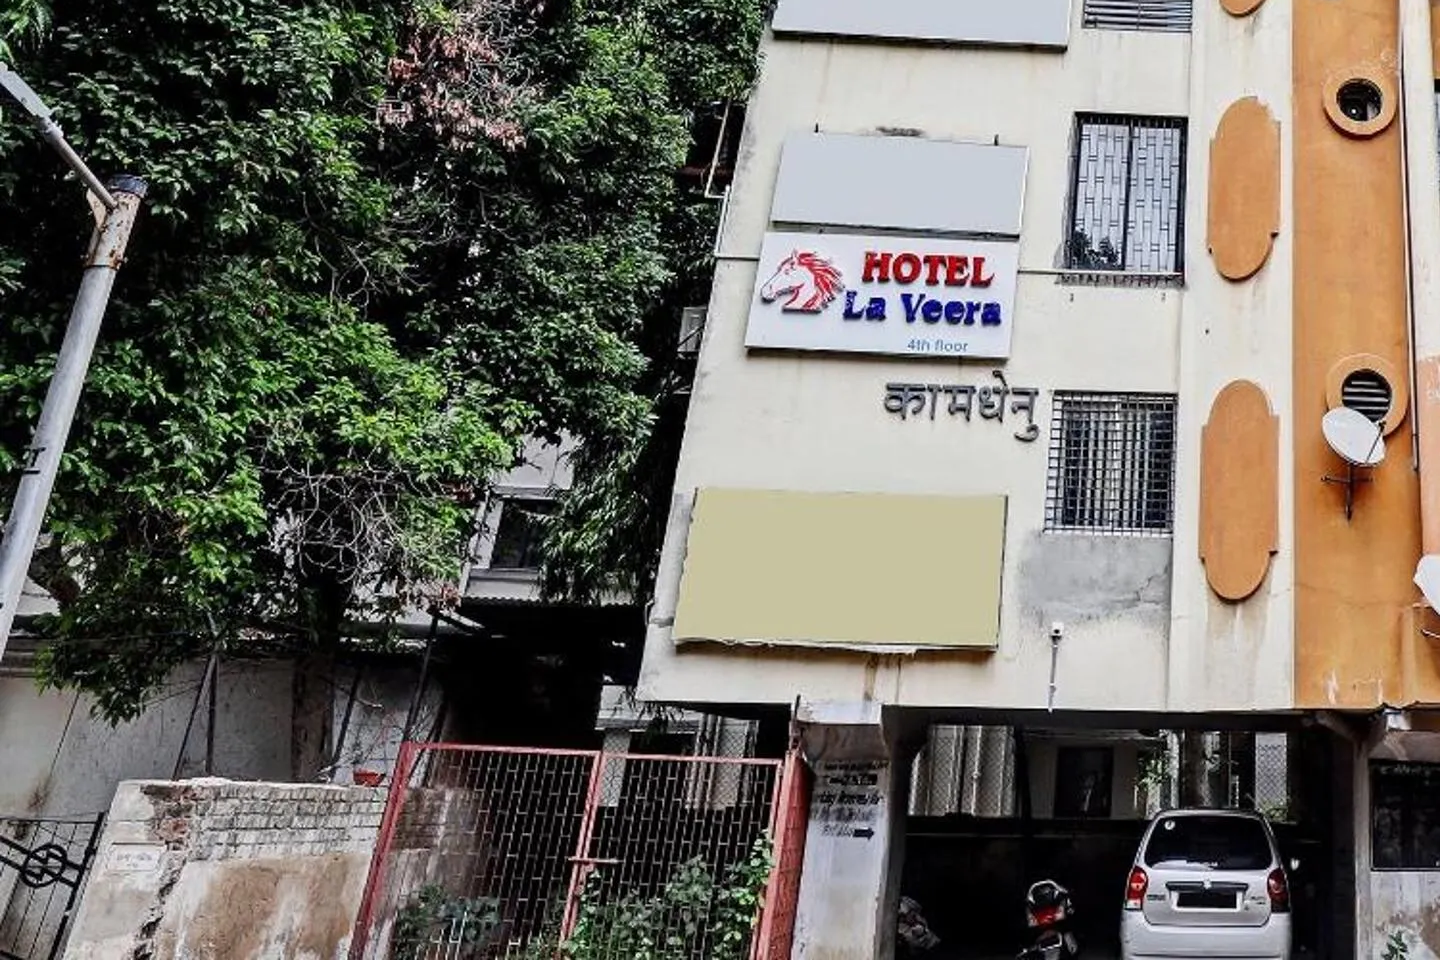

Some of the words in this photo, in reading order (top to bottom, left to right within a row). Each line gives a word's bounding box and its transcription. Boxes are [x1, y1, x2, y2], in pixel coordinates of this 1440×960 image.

[861, 251, 995, 288] HOTEL
[842, 291, 887, 322] La
[900, 293, 1002, 326] Veera
[907, 338, 931, 353] 4th
[934, 339, 969, 353] floor
[884, 370, 1041, 442] कामधेनु
